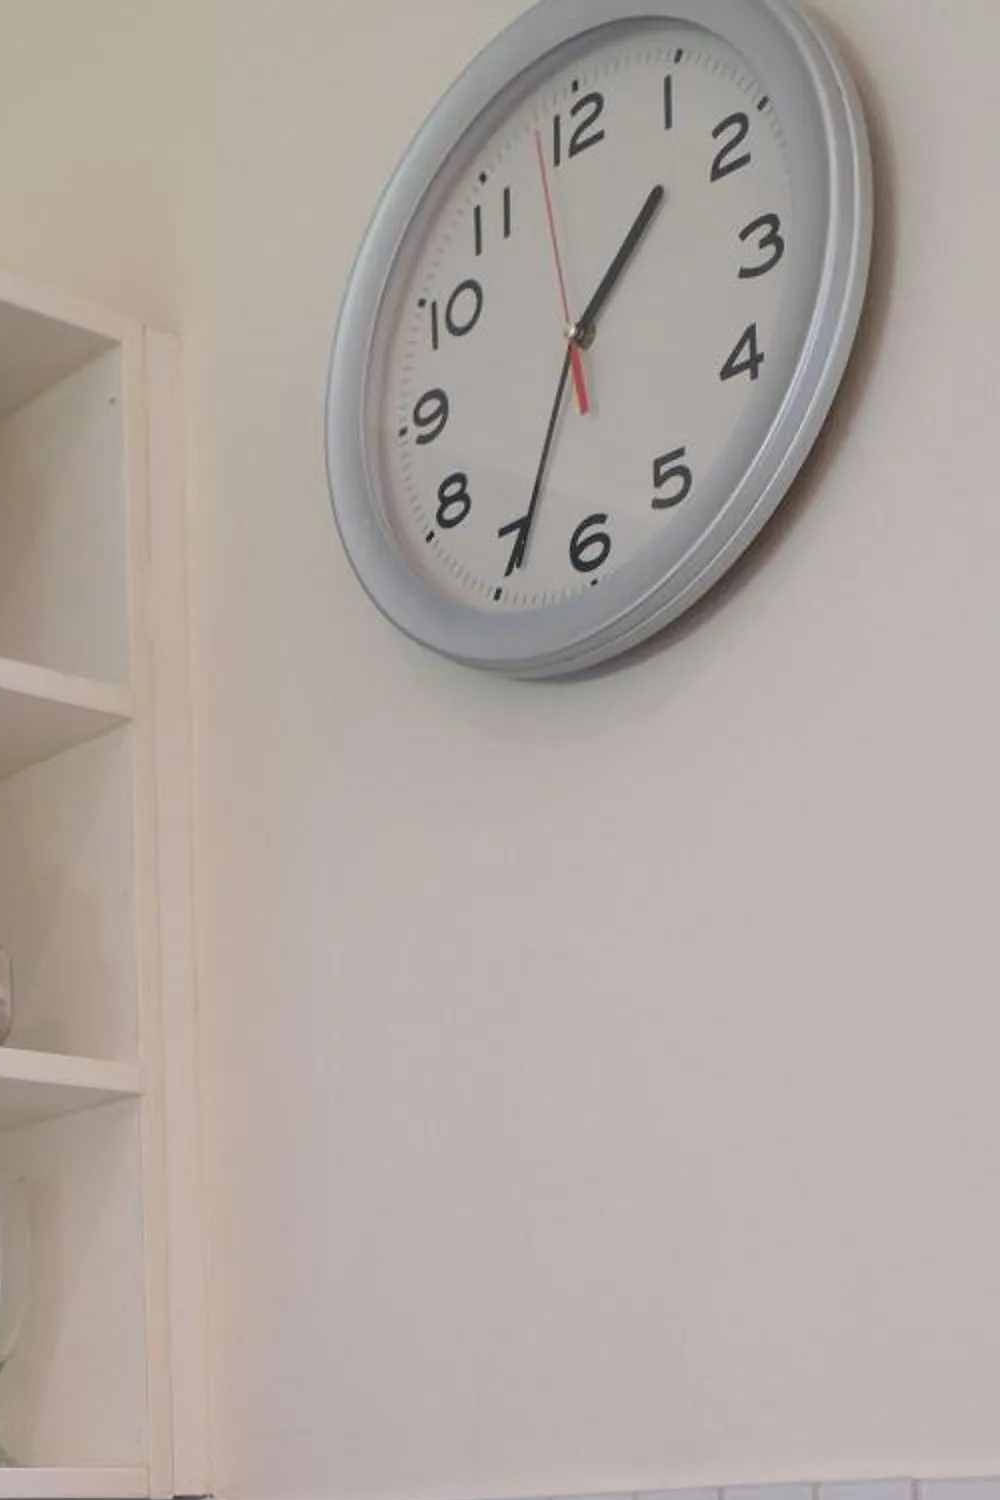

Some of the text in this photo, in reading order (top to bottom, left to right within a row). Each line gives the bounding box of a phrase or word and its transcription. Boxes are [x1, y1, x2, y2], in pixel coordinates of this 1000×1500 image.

[552, 90, 605, 167] 12
[663, 73, 673, 130] 1
[709, 110, 752, 182] 2
[472, 185, 512, 257] 11
[737, 212, 786, 280] 3
[429, 278, 484, 351] 10
[718, 322, 766, 382] 4
[412, 387, 450, 446] 9
[434, 471, 473, 530] 8
[650, 446, 693, 510] 5
[497, 513, 531, 578] 7
[568, 512, 613, 574] 6
